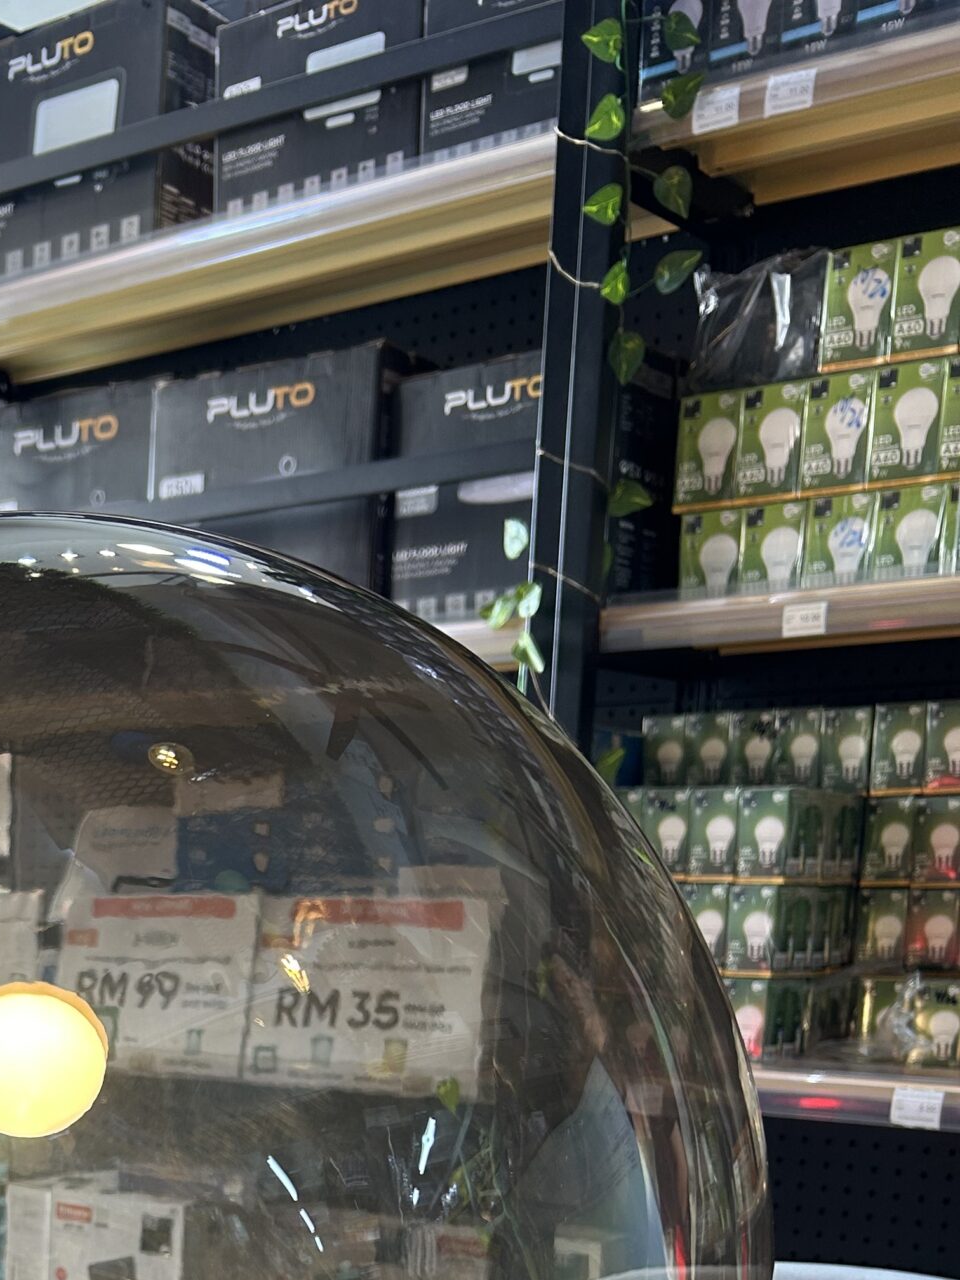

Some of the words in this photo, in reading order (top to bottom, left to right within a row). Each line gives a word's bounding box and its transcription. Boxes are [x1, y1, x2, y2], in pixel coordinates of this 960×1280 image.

[276, 0, 359, 39] PLUTO
[8, 31, 95, 82] PLUTO
[207, 382, 316, 423] PLUTO
[13, 415, 119, 456] PLUTO
[275, 988, 340, 1028] RM
[347, 989, 401, 1030] 35
